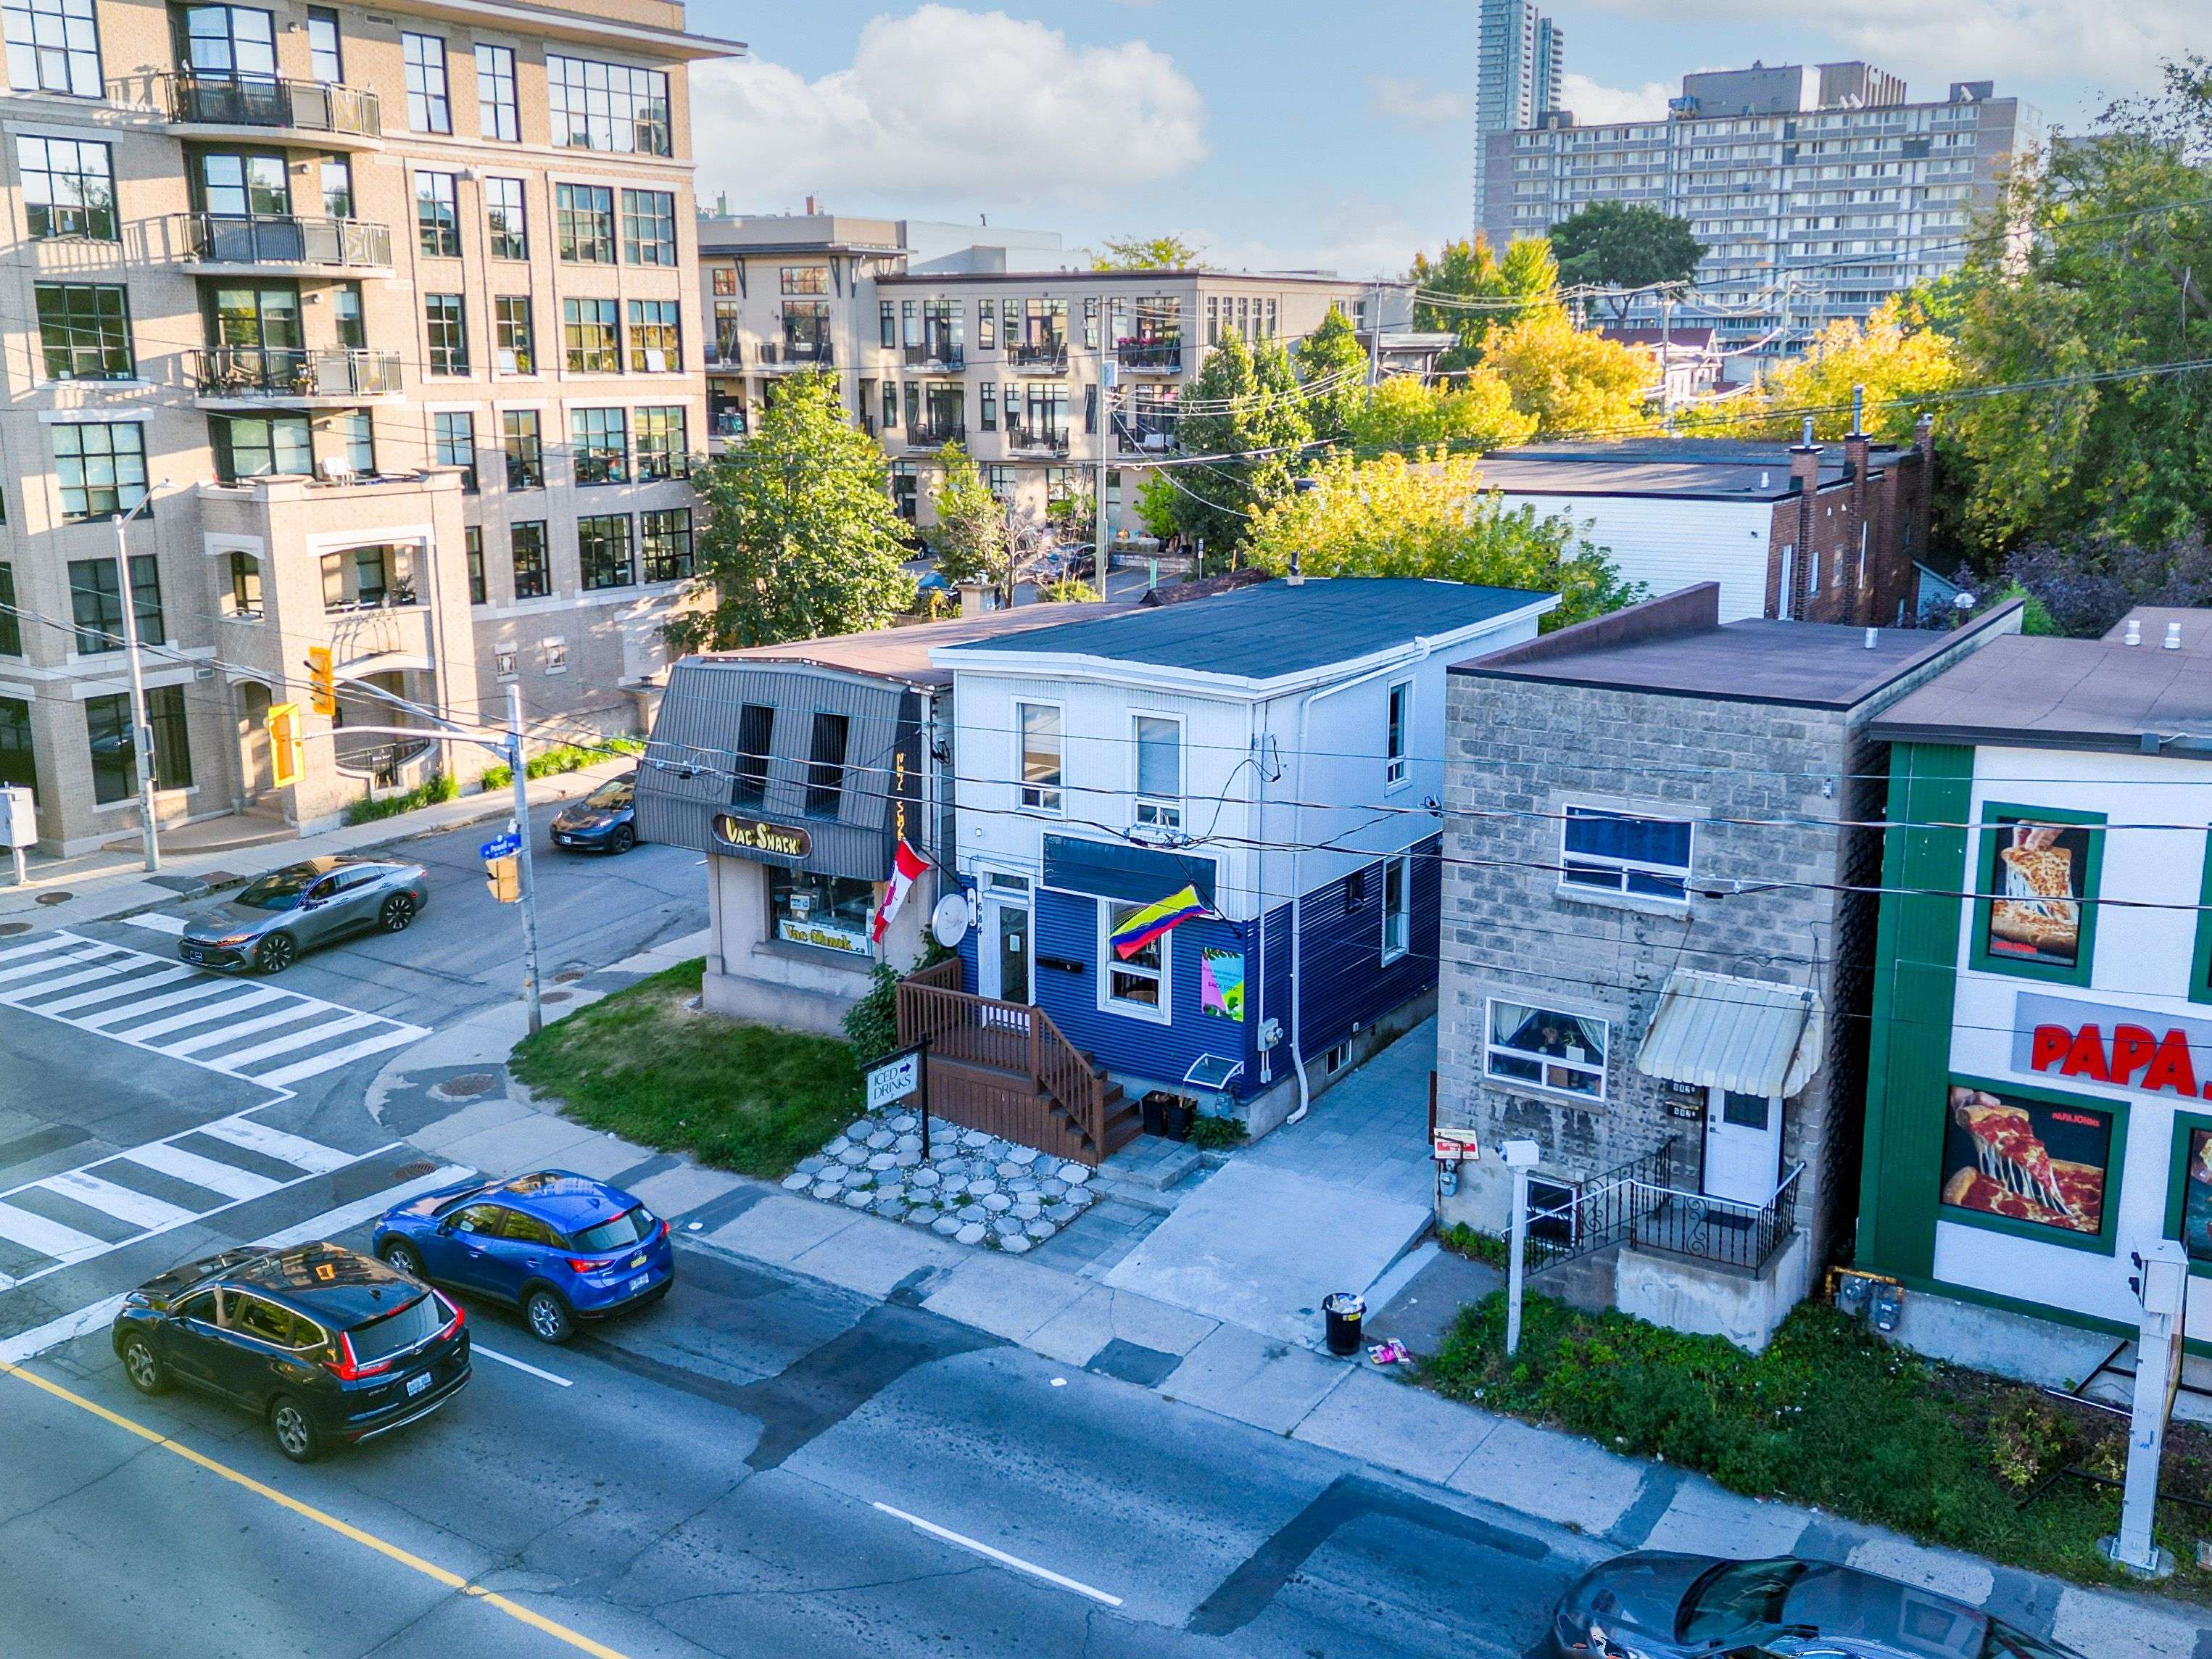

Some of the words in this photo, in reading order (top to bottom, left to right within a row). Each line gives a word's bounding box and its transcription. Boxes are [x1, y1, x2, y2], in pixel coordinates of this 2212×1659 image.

[2031, 1023, 2197, 1097] PAPA
[874, 1067, 898, 1086] ICED
[874, 1075, 911, 1099] DRINKS
